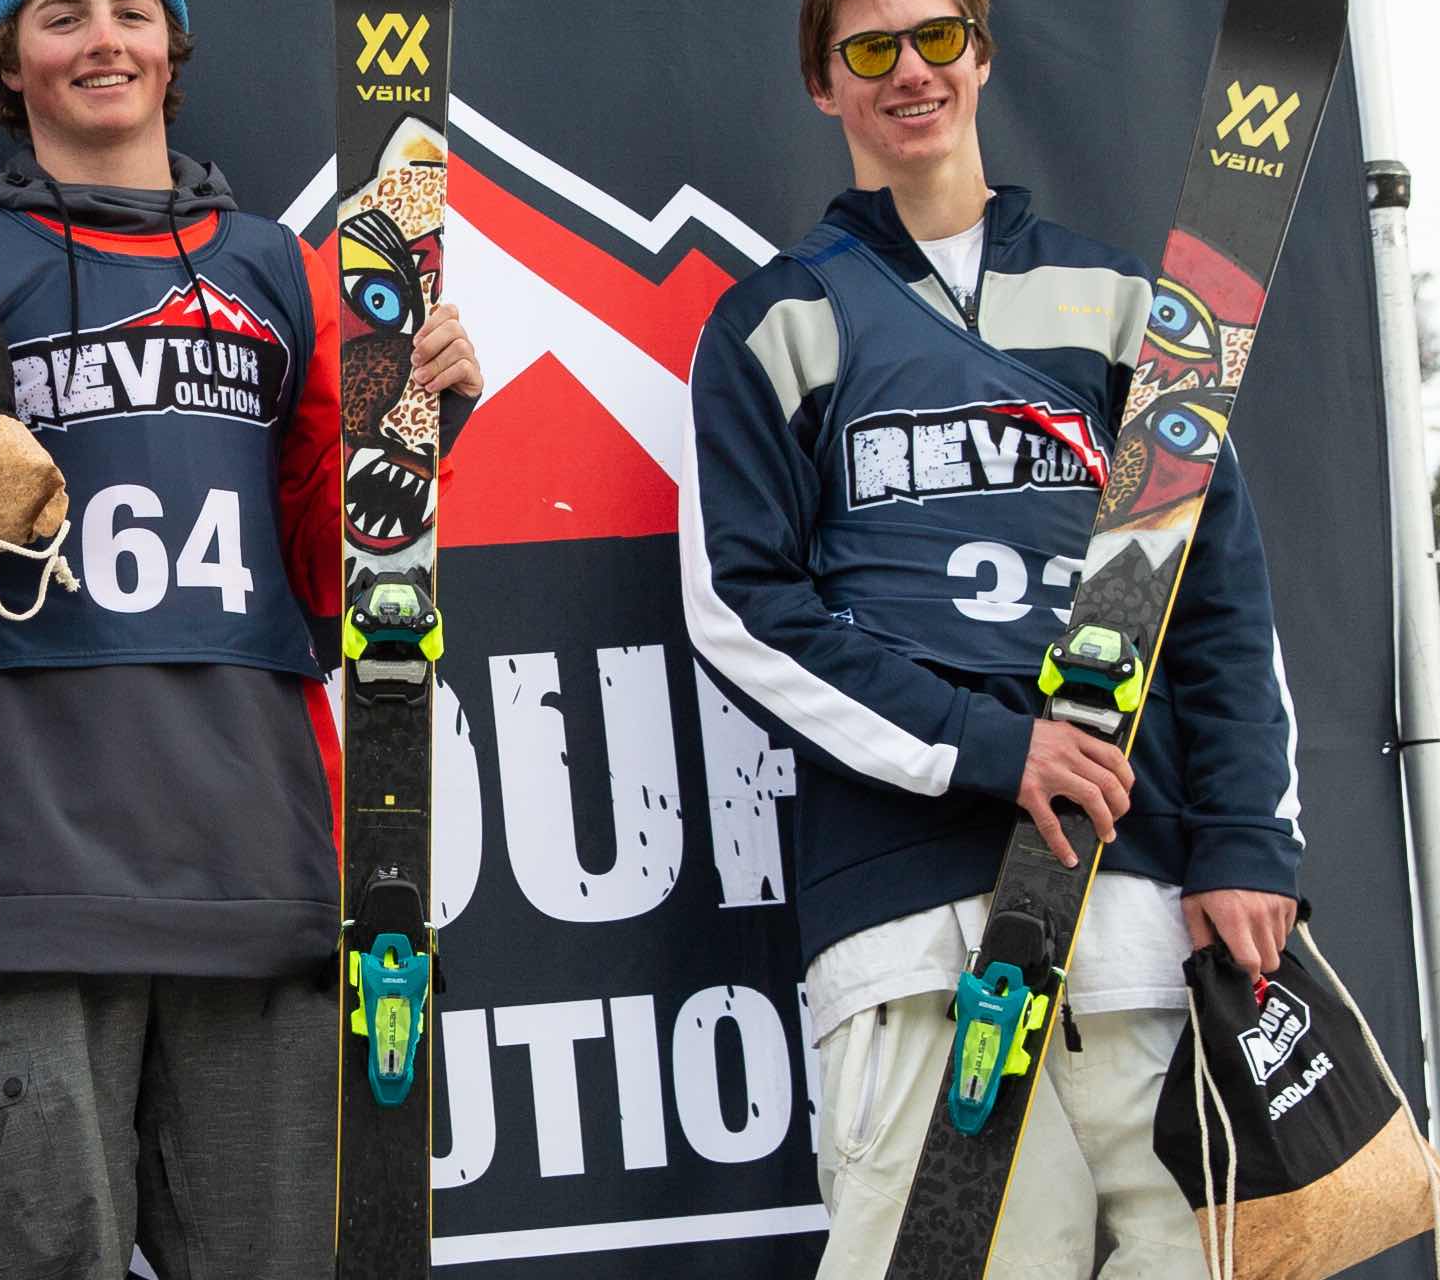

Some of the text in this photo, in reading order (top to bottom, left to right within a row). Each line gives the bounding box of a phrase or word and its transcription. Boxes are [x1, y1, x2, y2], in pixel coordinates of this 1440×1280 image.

[356, 85, 430, 102] Völkl
[11, 338, 259, 425] REV TOUR
[852, 419, 1022, 501] REV
[80, 484, 254, 614] 64
